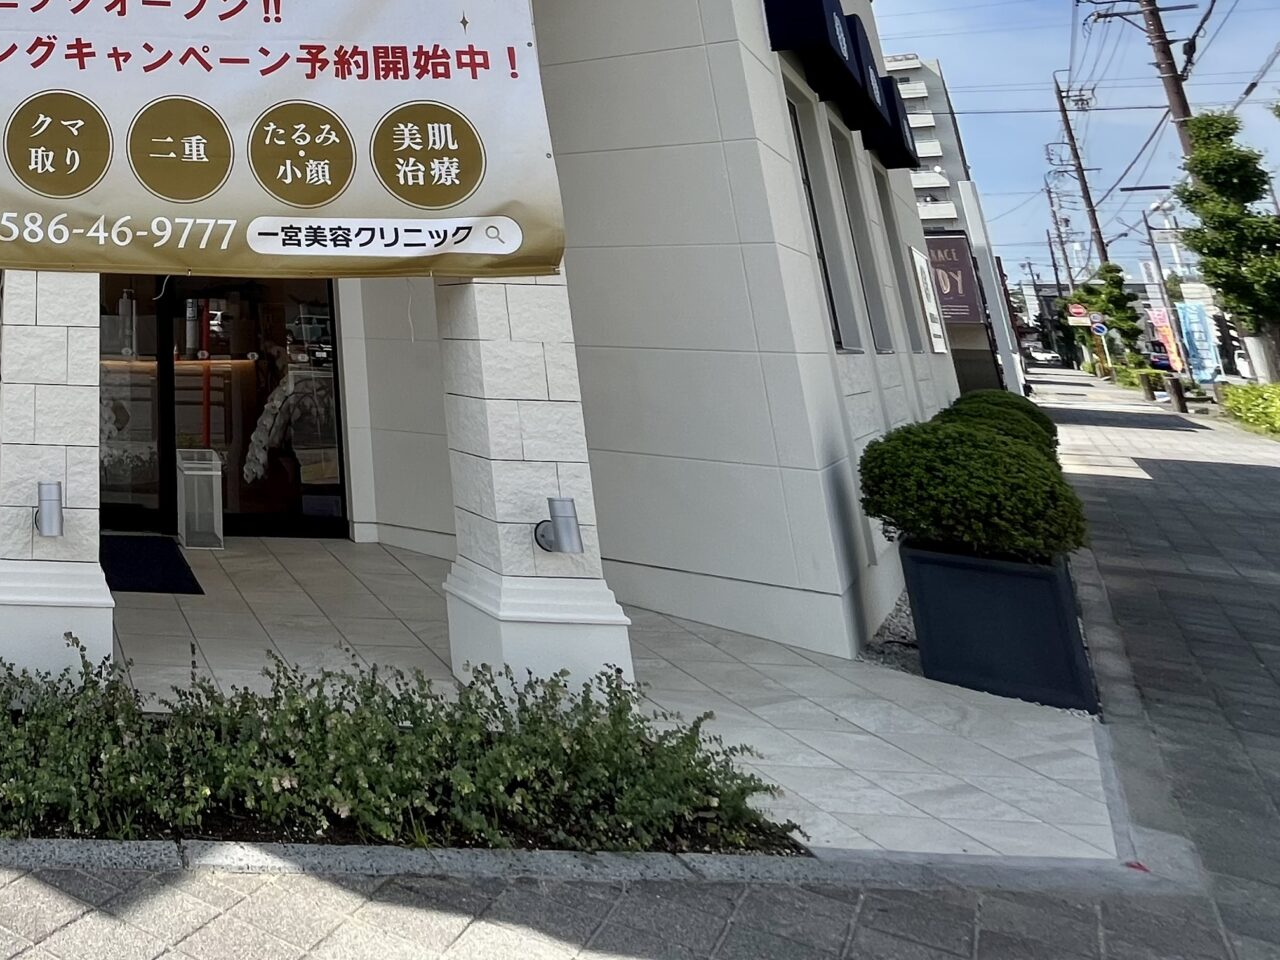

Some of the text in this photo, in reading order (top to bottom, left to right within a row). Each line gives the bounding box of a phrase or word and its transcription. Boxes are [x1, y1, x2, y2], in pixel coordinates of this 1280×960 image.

[29, 113, 86, 138] クマ
[392, 122, 458, 152] 美肌
[28, 147, 82, 176] 取り
[149, 135, 210, 164] 二重
[276, 159, 331, 187] 小顔
[394, 158, 462, 187] 治療
[257, 223, 473, 249] 一宮美容クリニック
